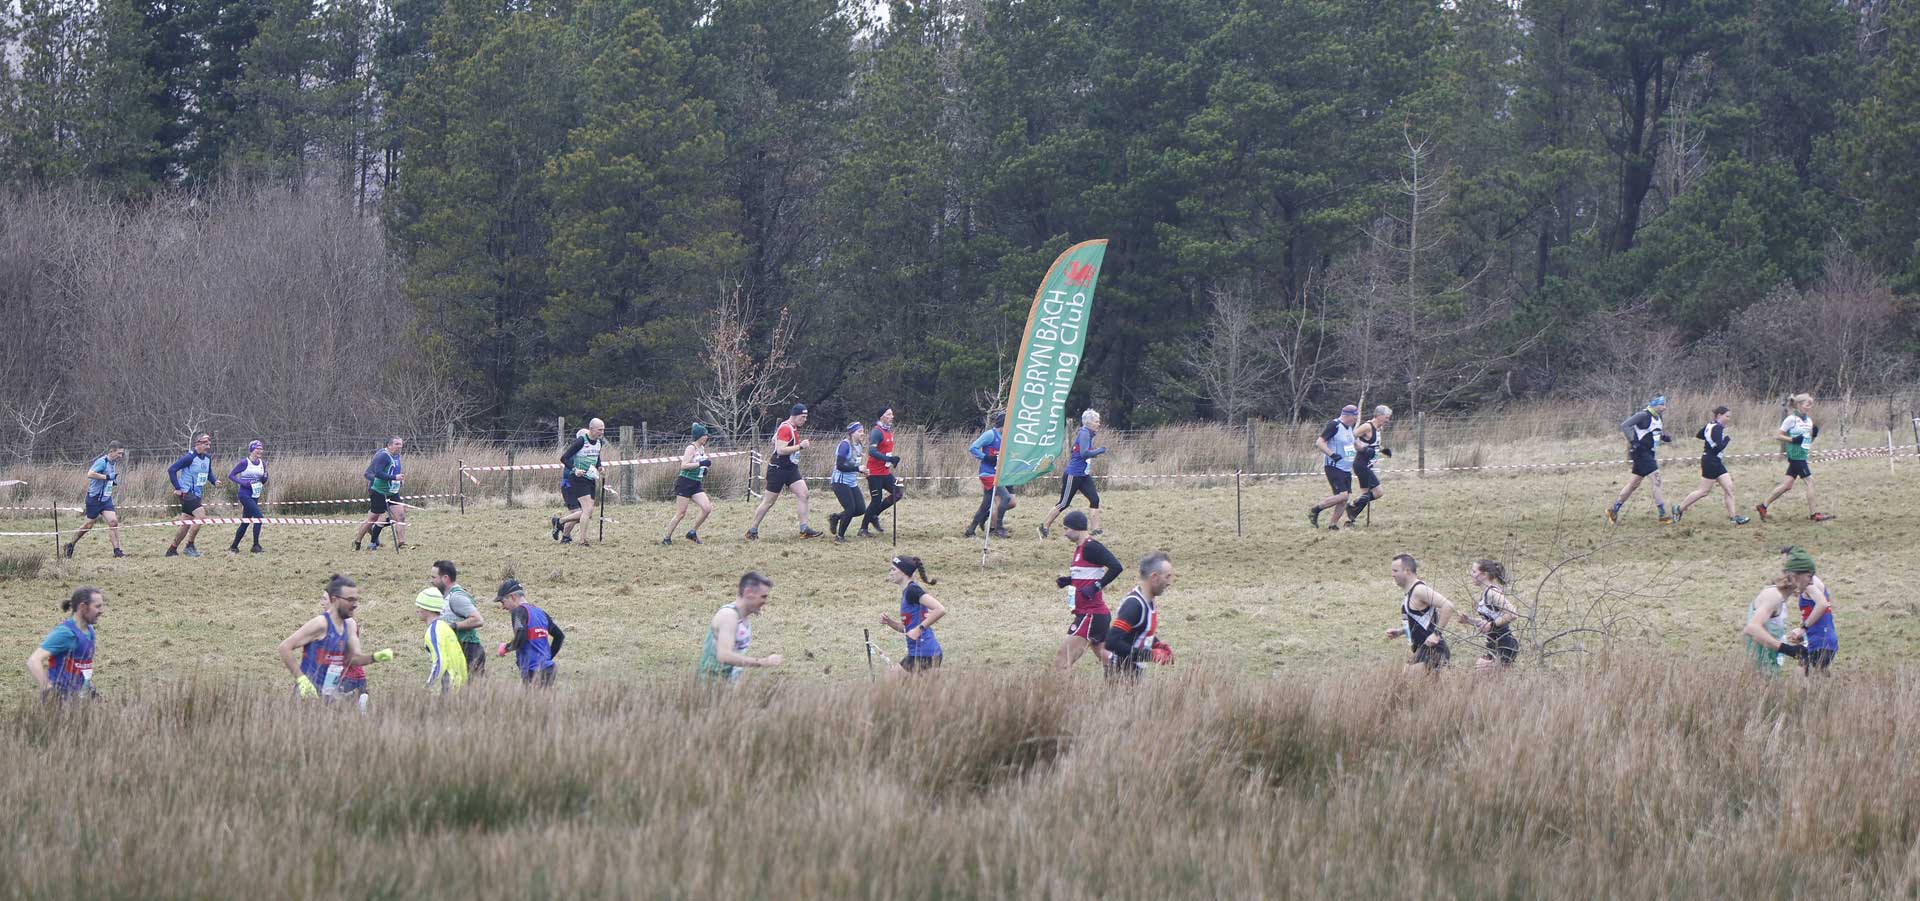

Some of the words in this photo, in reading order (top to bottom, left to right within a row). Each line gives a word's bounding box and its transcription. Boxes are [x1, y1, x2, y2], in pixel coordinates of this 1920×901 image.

[1036, 290, 1067, 341] BACH
[1024, 344, 1055, 395] BRYN
[1039, 353, 1079, 447] Running
[1060, 292, 1086, 345] Club
[1014, 396, 1043, 446] PARC
